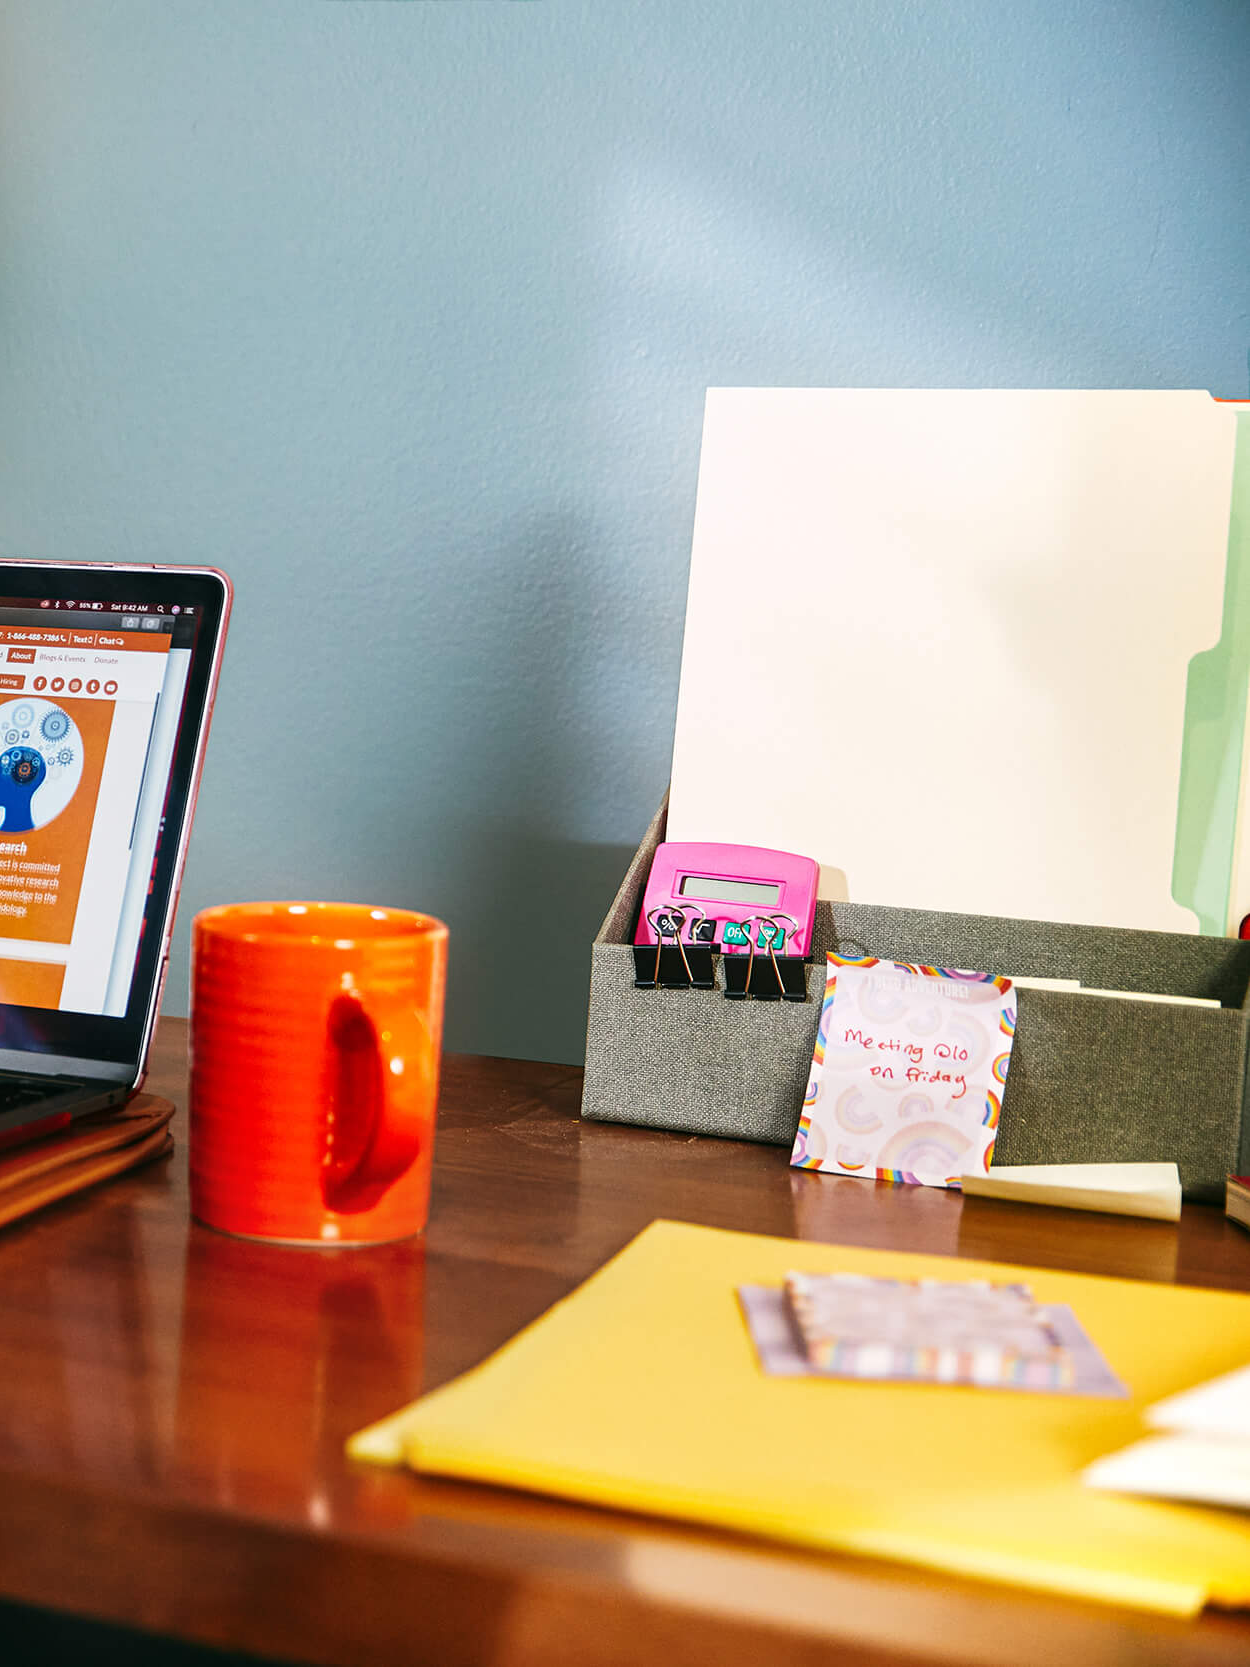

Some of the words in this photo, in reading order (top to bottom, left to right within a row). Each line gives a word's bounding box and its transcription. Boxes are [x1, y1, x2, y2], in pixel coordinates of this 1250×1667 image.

[111, 603, 121, 611] Sat
[73, 635, 88, 643] Text
[99, 637, 114, 645] Chat
[11, 651, 32, 660] About
[39, 653, 56, 662] Blogs
[64, 655, 86, 663] Events
[0, 678, 17, 687] Hiring
[12, 859, 18, 871] is
[19, 861, 61, 875] committed
[25, 876, 59, 890] research
[34, 893, 43, 904] to
[43, 892, 58, 905] the
[845, 1029, 923, 1063] Meeting
[869, 1066, 894, 1079] on
